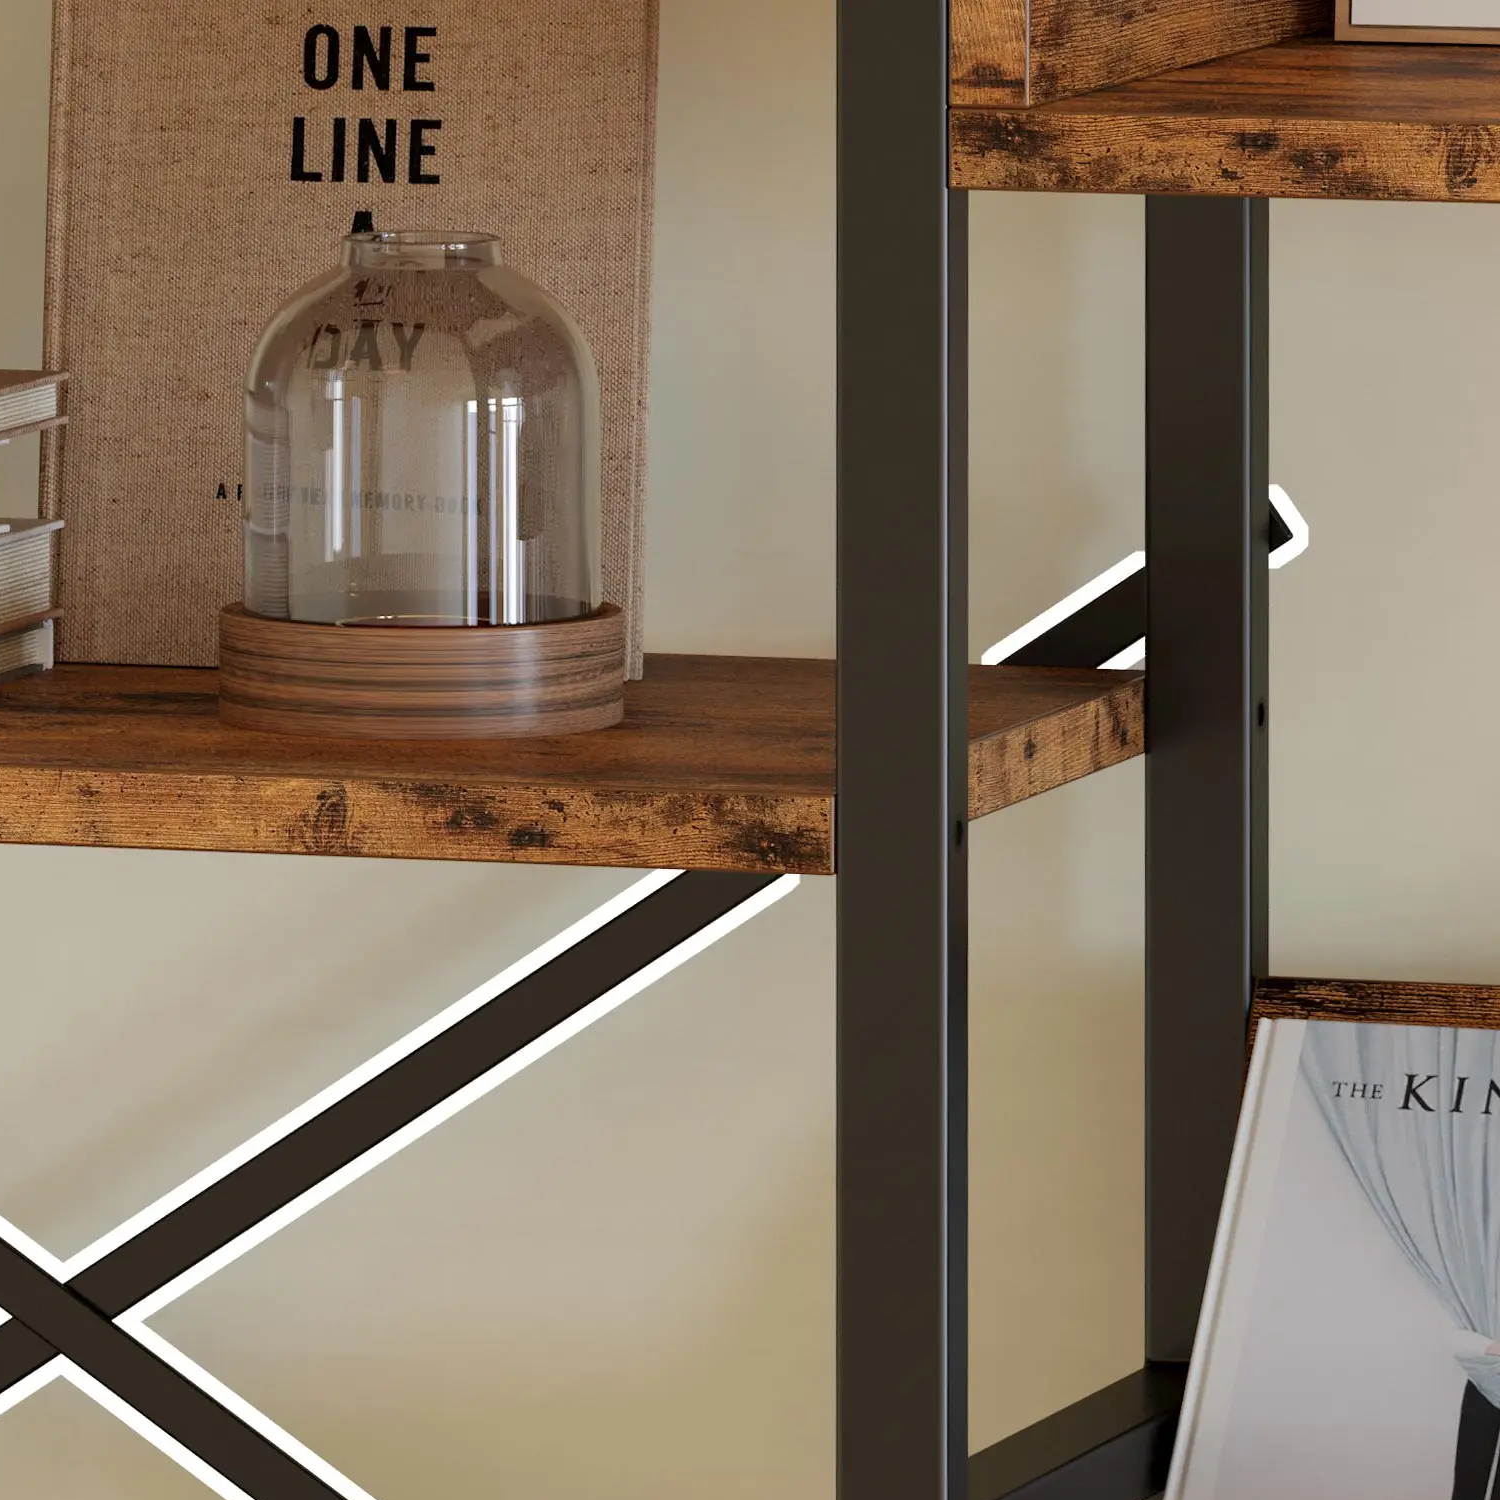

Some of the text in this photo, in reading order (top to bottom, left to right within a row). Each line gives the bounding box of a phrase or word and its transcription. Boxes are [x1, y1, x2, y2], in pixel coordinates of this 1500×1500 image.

[303, 23, 438, 91] ONE
[290, 116, 442, 185] LINE
[1332, 1081, 1384, 1100] THE
